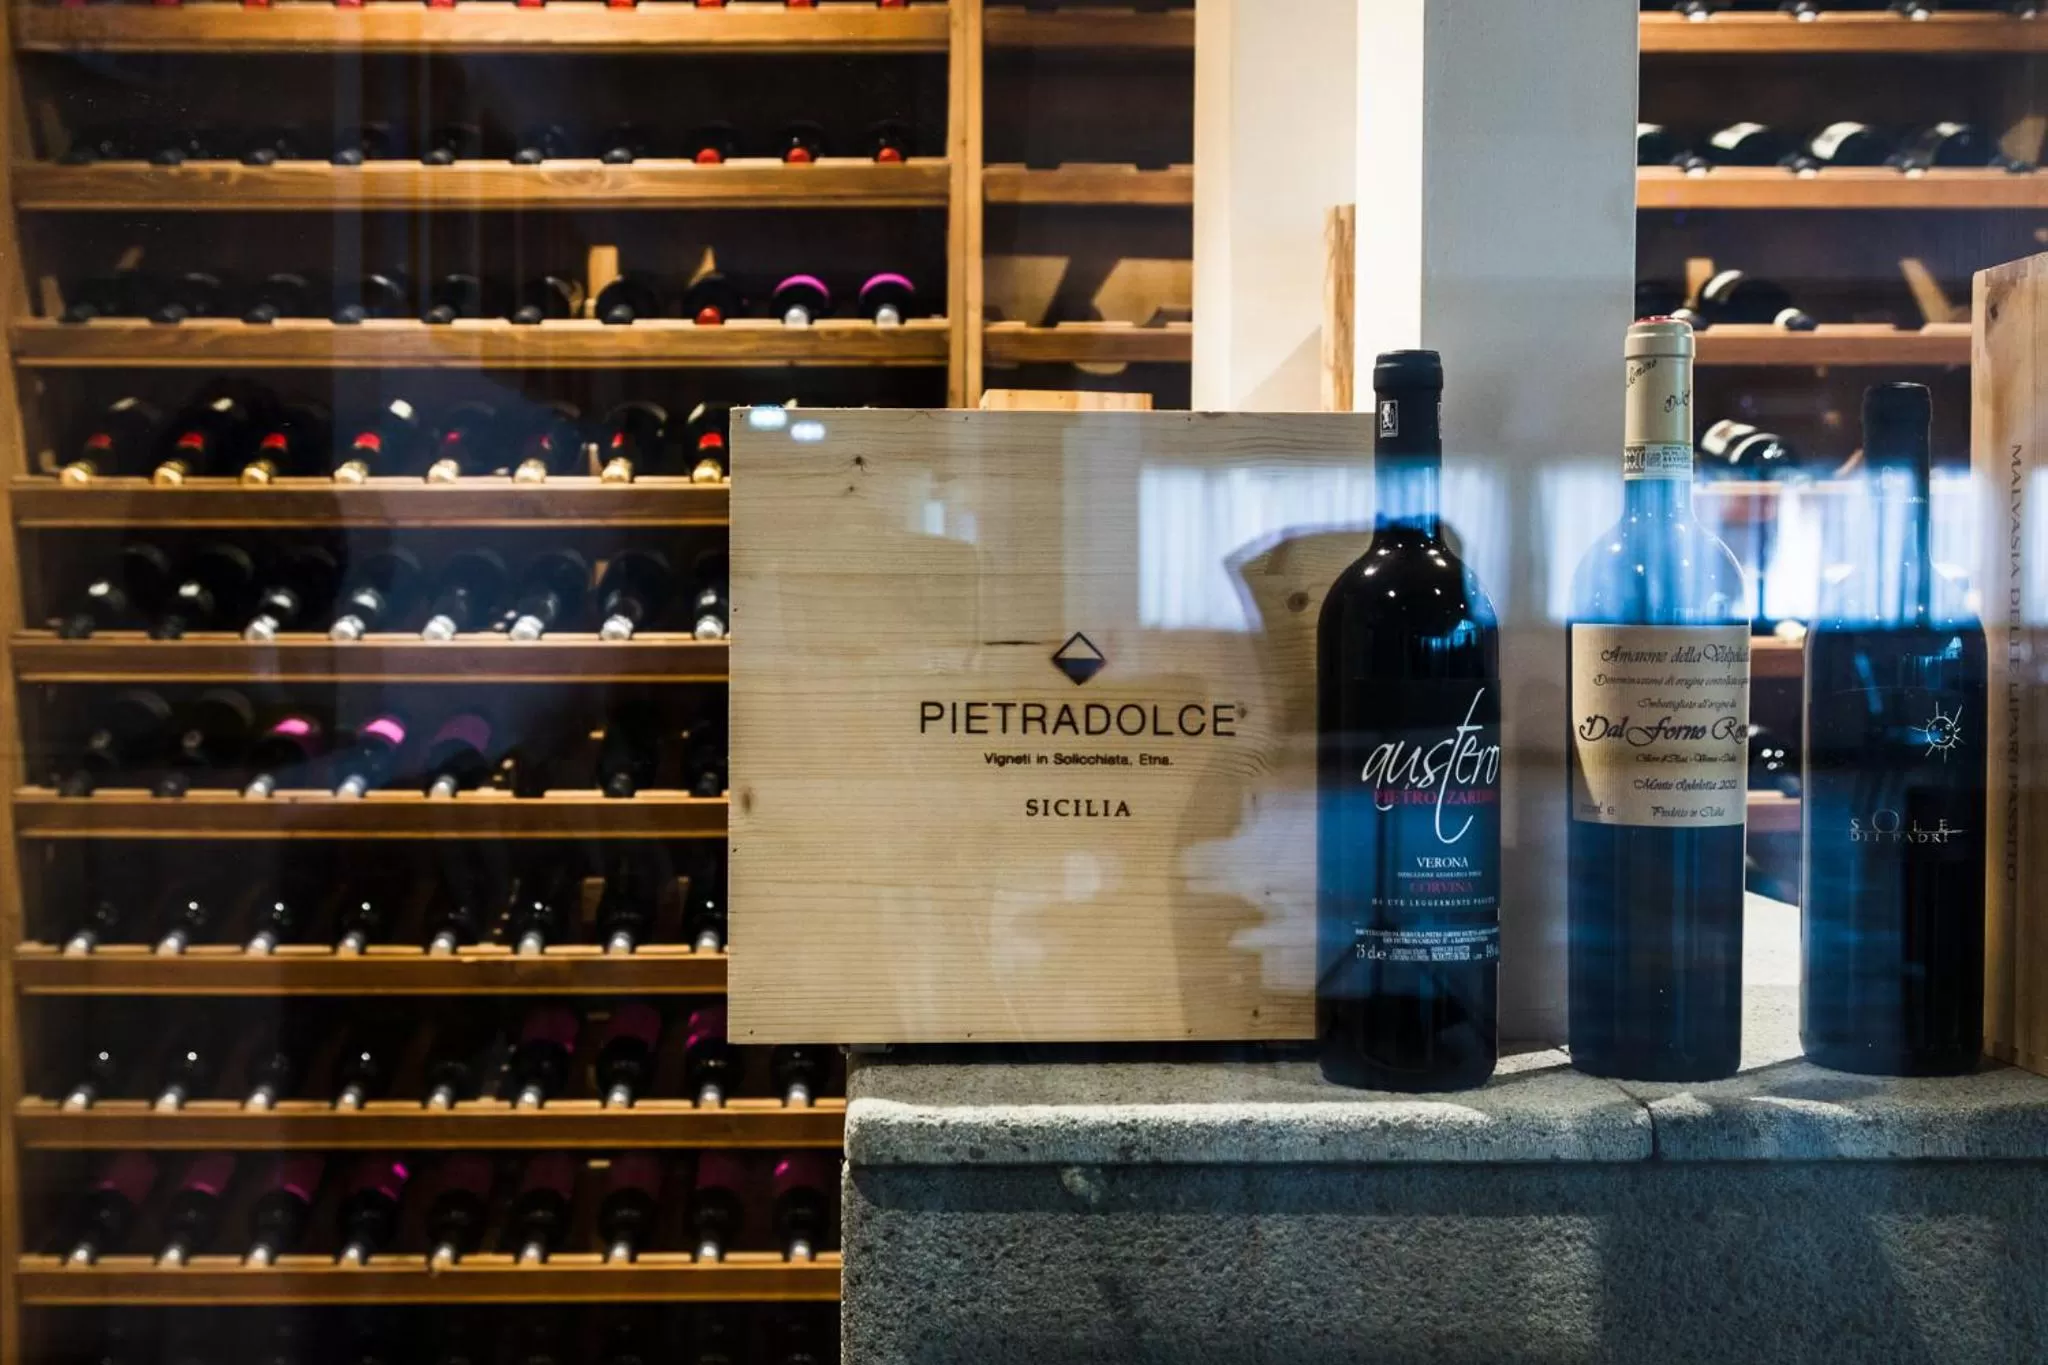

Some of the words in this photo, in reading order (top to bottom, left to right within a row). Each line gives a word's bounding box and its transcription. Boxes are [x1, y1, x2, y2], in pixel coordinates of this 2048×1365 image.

[2010, 444, 2022, 579] MALVASIA
[2010, 587, 2021, 672] DELLE
[1601, 646, 1668, 664] Amarone
[1671, 646, 1701, 663] della
[920, 701, 1238, 737] PIETRADOLCE
[1579, 714, 1628, 742] Dal
[1626, 716, 1706, 747] Forno
[2008, 683, 2020, 765] LIPARI
[984, 752, 1032, 766] Vigneti
[1036, 753, 1048, 765] in
[1053, 753, 1133, 767] Solicchiata,
[1139, 754, 1174, 766] Etna.
[1361, 688, 1500, 843] austero
[1026, 800, 1131, 817] SICILIA
[1651, 806, 1687, 817] Prodotto
[1700, 806, 1725, 817] Italia
[1417, 857, 1469, 868] VERONA
